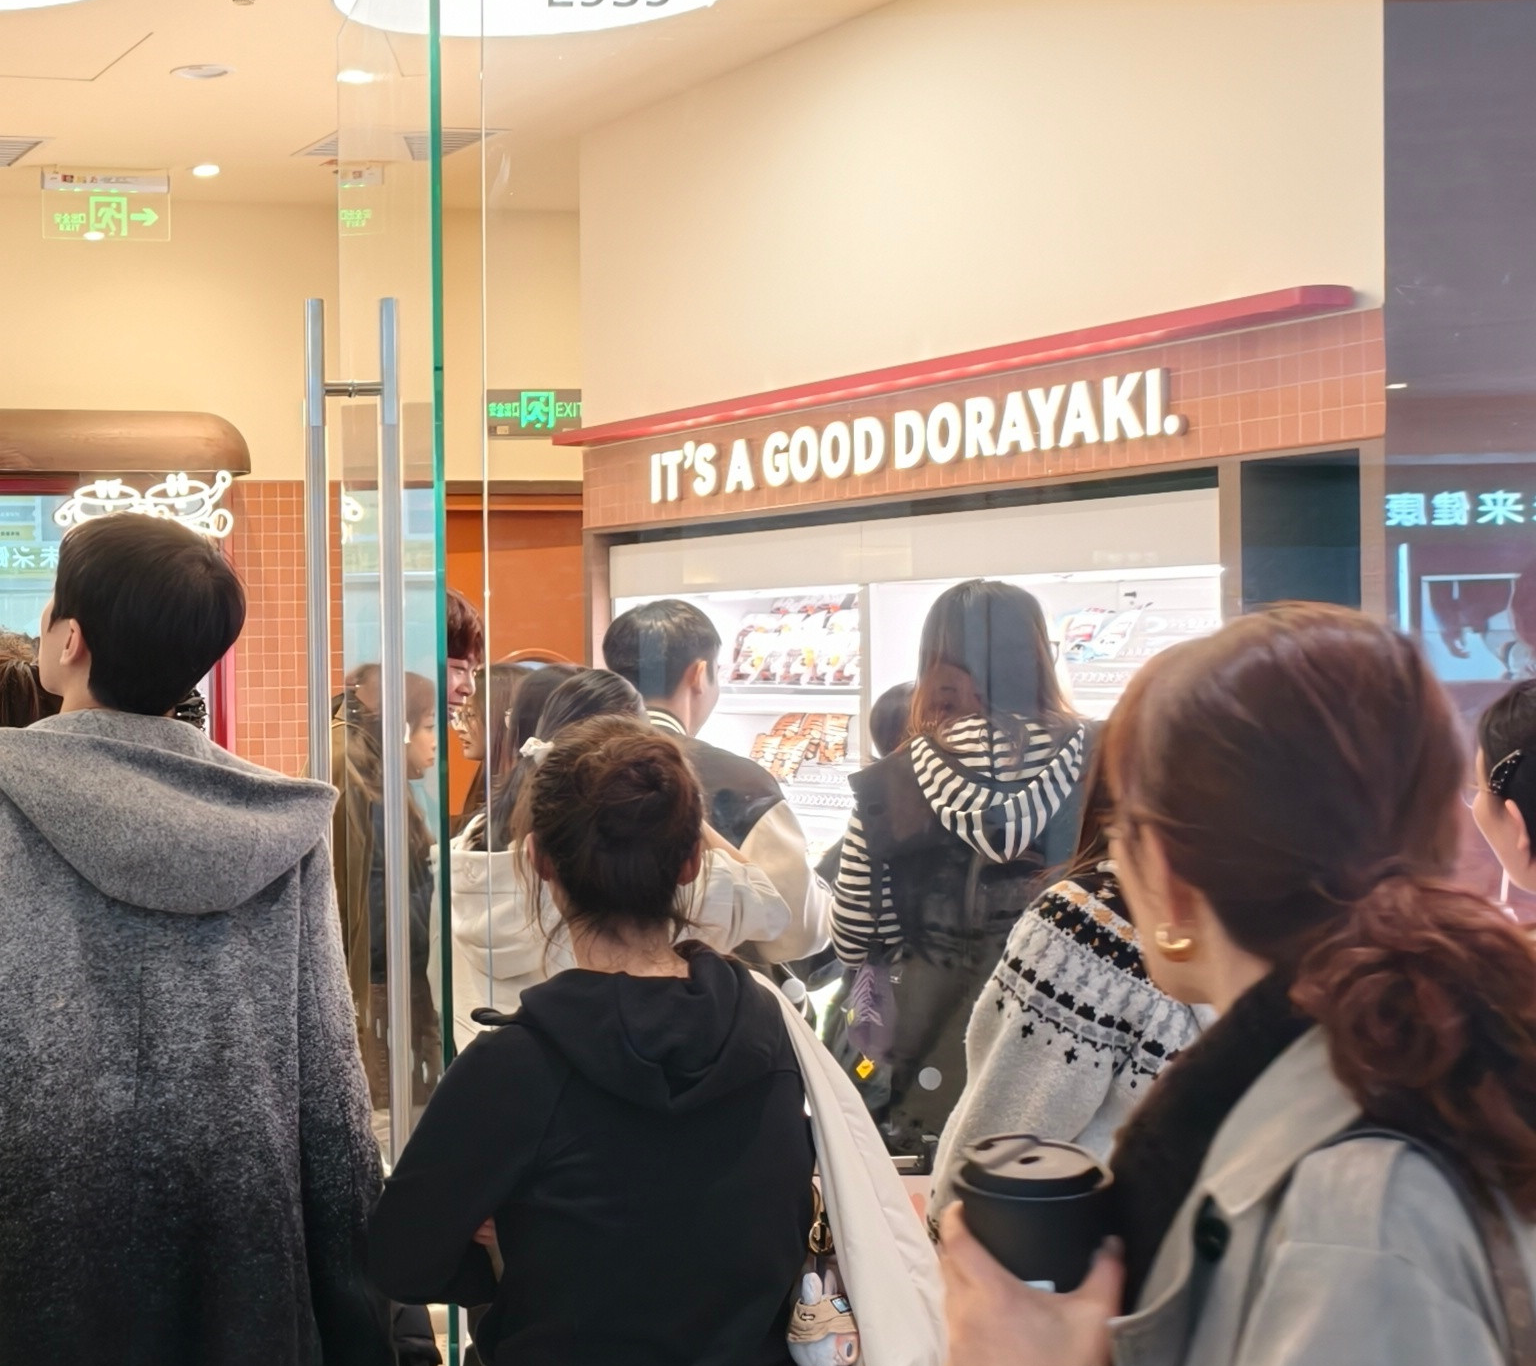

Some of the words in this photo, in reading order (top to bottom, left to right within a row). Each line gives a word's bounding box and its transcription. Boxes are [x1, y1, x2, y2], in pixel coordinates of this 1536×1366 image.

[555, 401, 583, 418] EXIT
[649, 440, 718, 505] IT'S
[725, 438, 755, 493] A
[763, 415, 886, 488] GOOD
[893, 367, 1183, 471] DORAYAKI.
